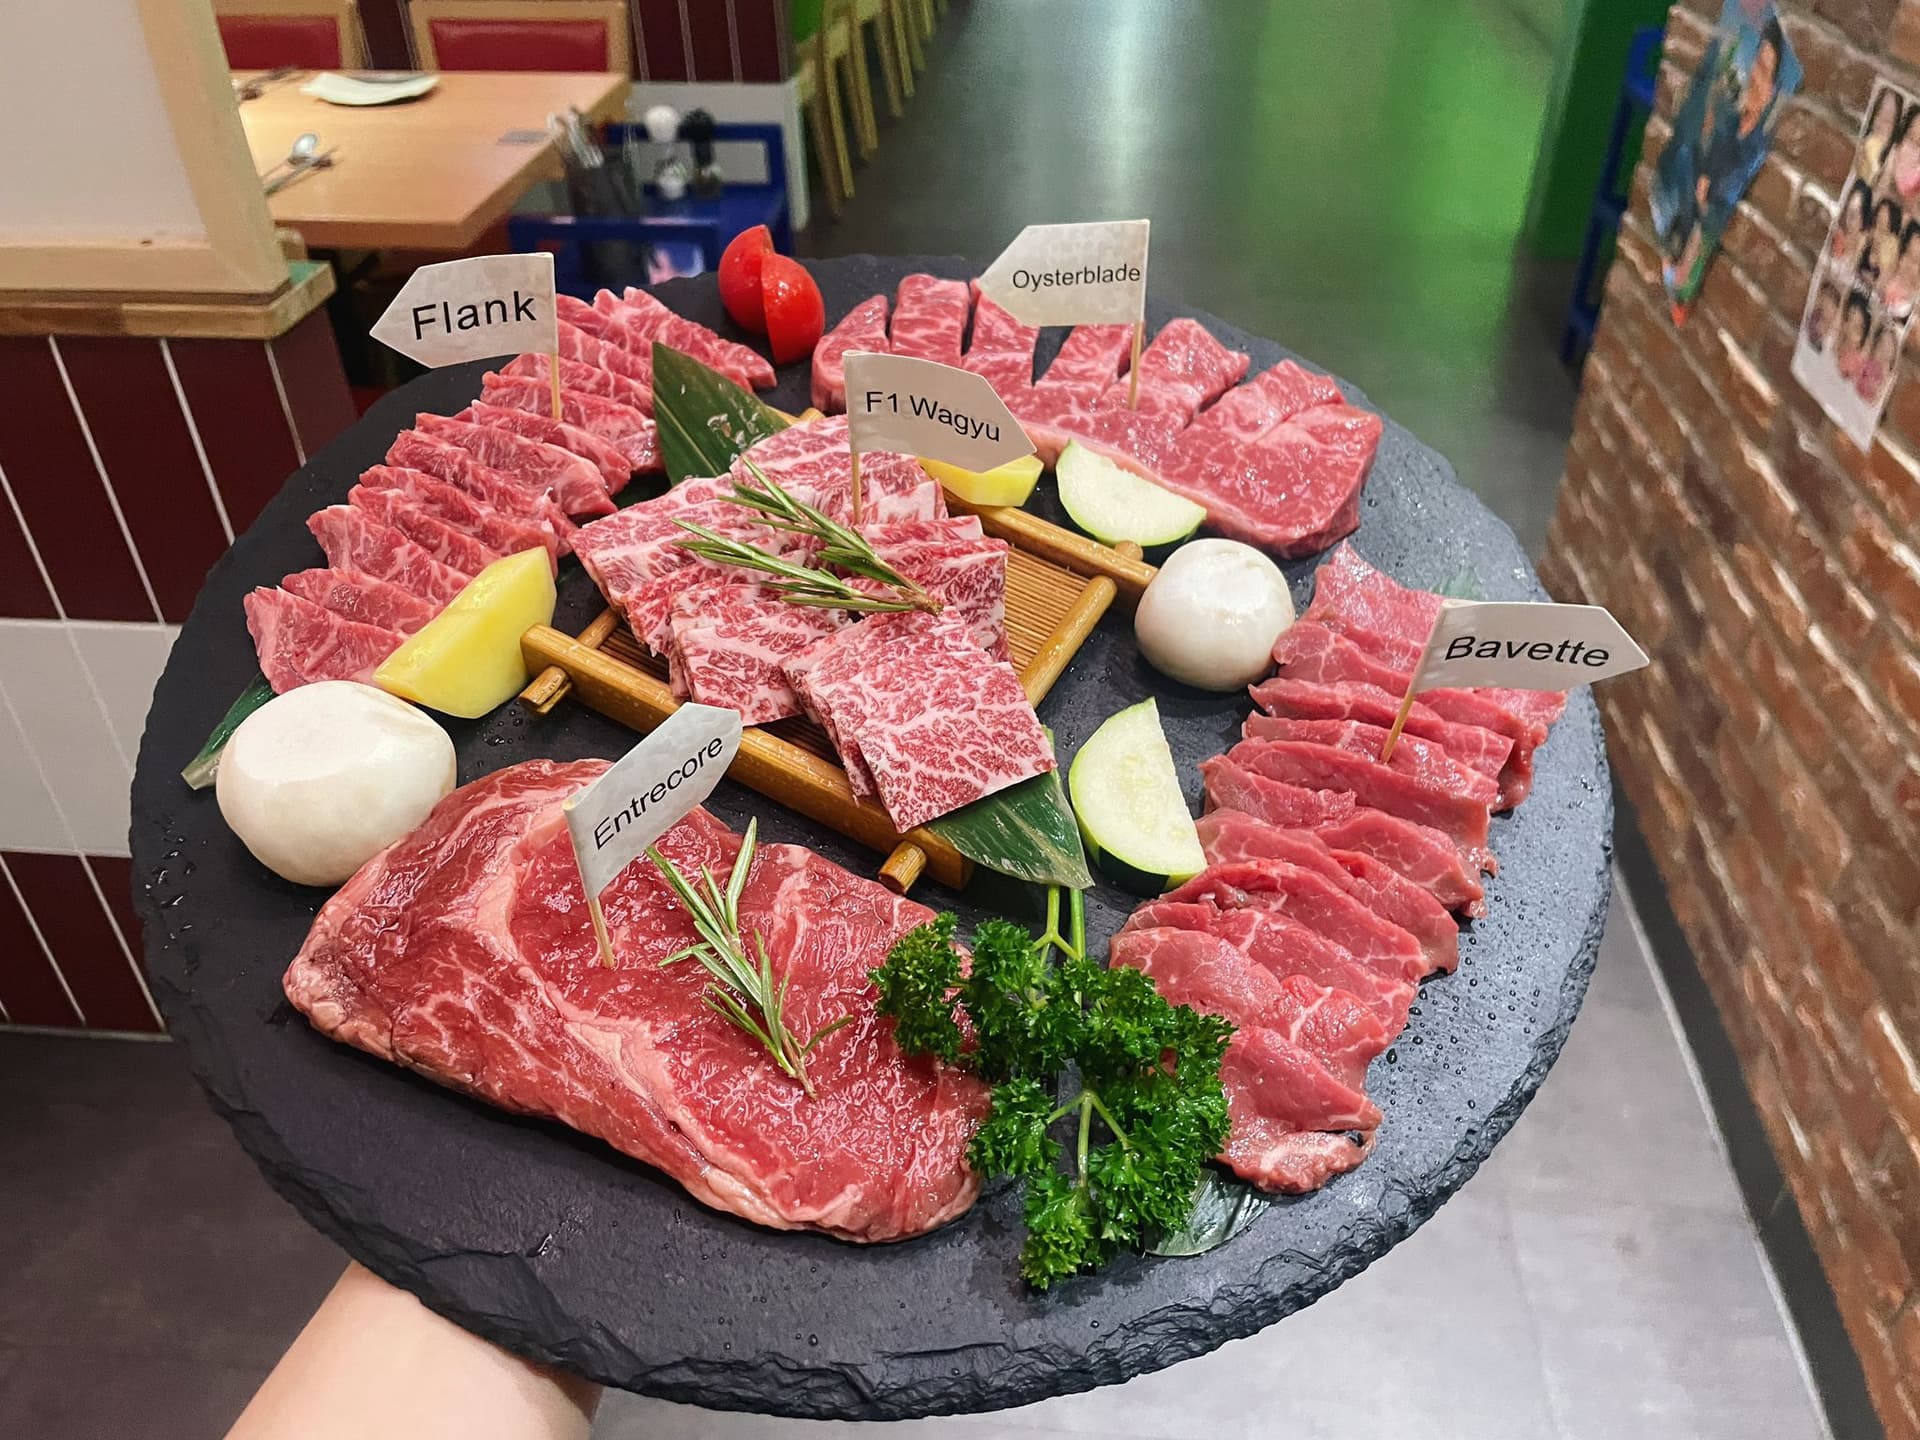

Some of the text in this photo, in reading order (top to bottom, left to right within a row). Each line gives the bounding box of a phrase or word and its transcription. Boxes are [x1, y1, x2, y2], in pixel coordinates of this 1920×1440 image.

[1012, 264, 1142, 292] Oysterblade
[412, 291, 537, 341] Flank
[866, 391, 1001, 443] F1 Wagyu
[1445, 635, 1611, 668] Bavette
[594, 737, 723, 851] Entrecore
